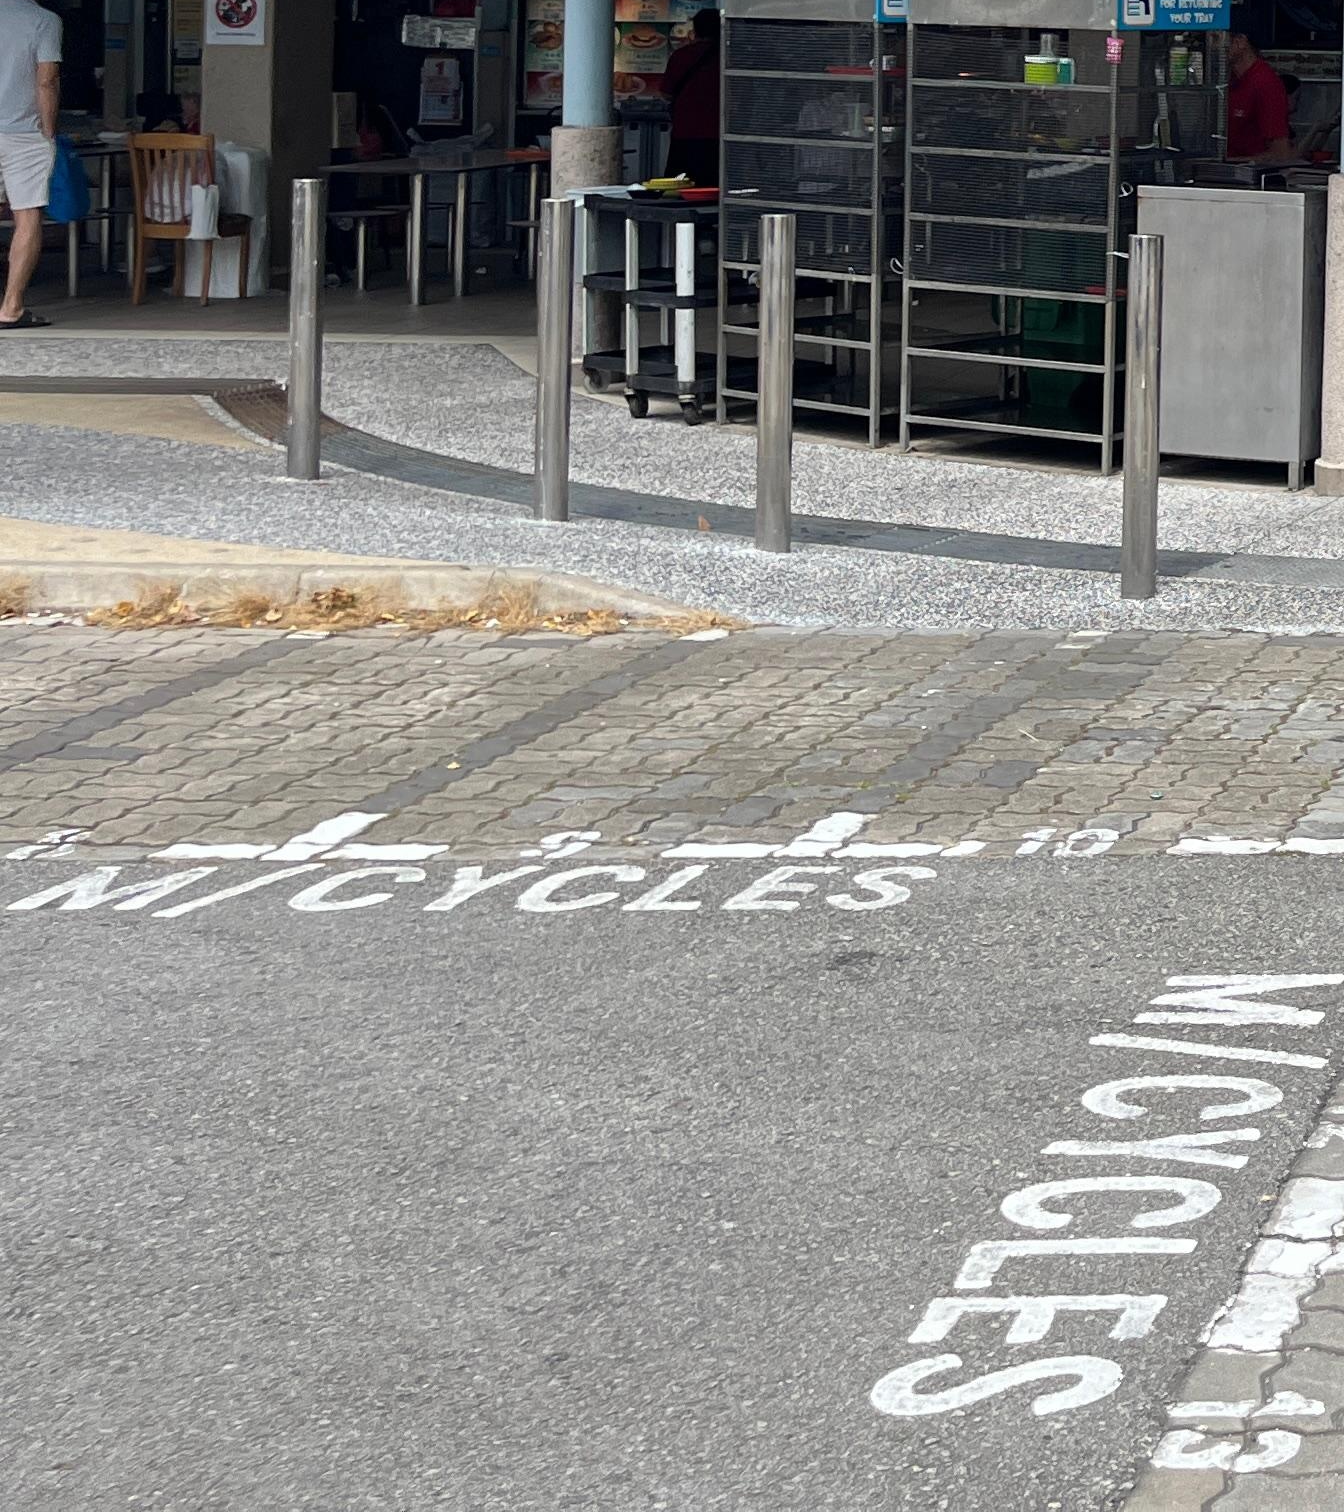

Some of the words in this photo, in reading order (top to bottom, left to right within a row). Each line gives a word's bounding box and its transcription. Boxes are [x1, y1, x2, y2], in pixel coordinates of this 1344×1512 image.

[1169, 13, 1191, 24] YOUR
[1193, 13, 1215, 24] TRAY
[1015, 828, 1120, 857] 10
[5, 863, 940, 919] M/CYCLES
[1151, 1391, 1326, 1474] 13
